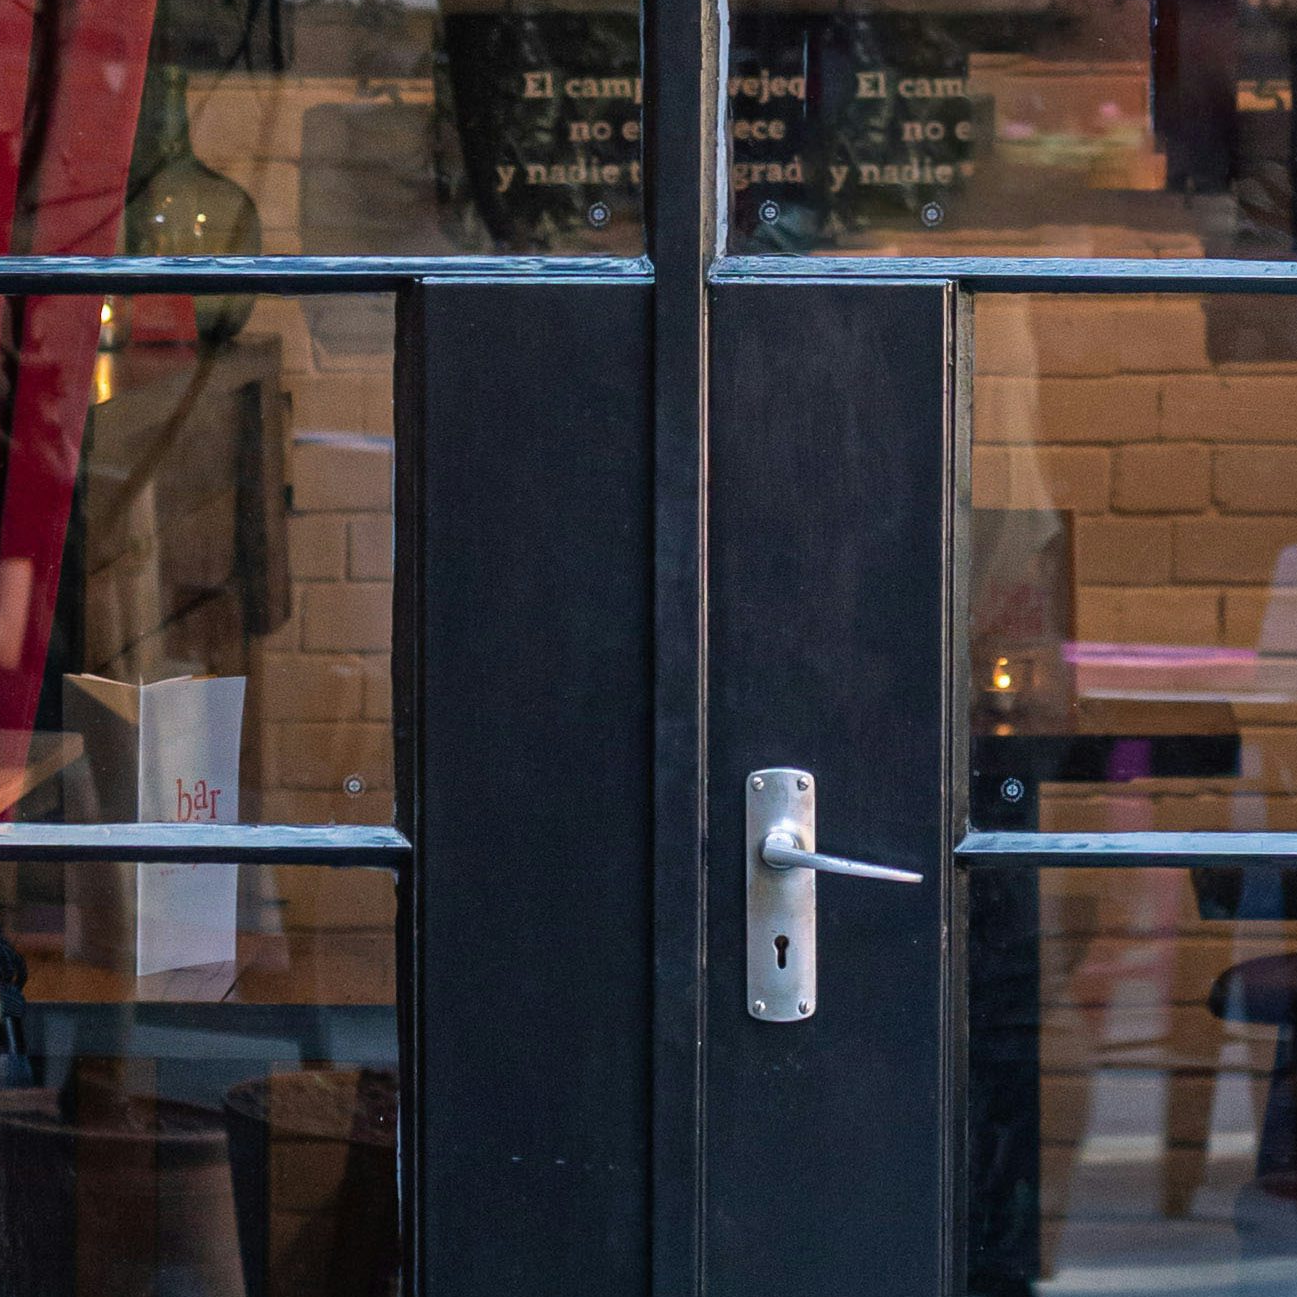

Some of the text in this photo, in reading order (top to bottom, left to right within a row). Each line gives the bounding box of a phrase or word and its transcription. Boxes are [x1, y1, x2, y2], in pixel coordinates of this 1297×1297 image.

[523, 70, 554, 99] El
[856, 70, 887, 99] El
[569, 120, 612, 142] no
[902, 120, 945, 142] no
[496, 164, 515, 192] y
[526, 154, 622, 185] nadie
[829, 154, 954, 193] y nadie
[175, 777, 222, 823] bar
